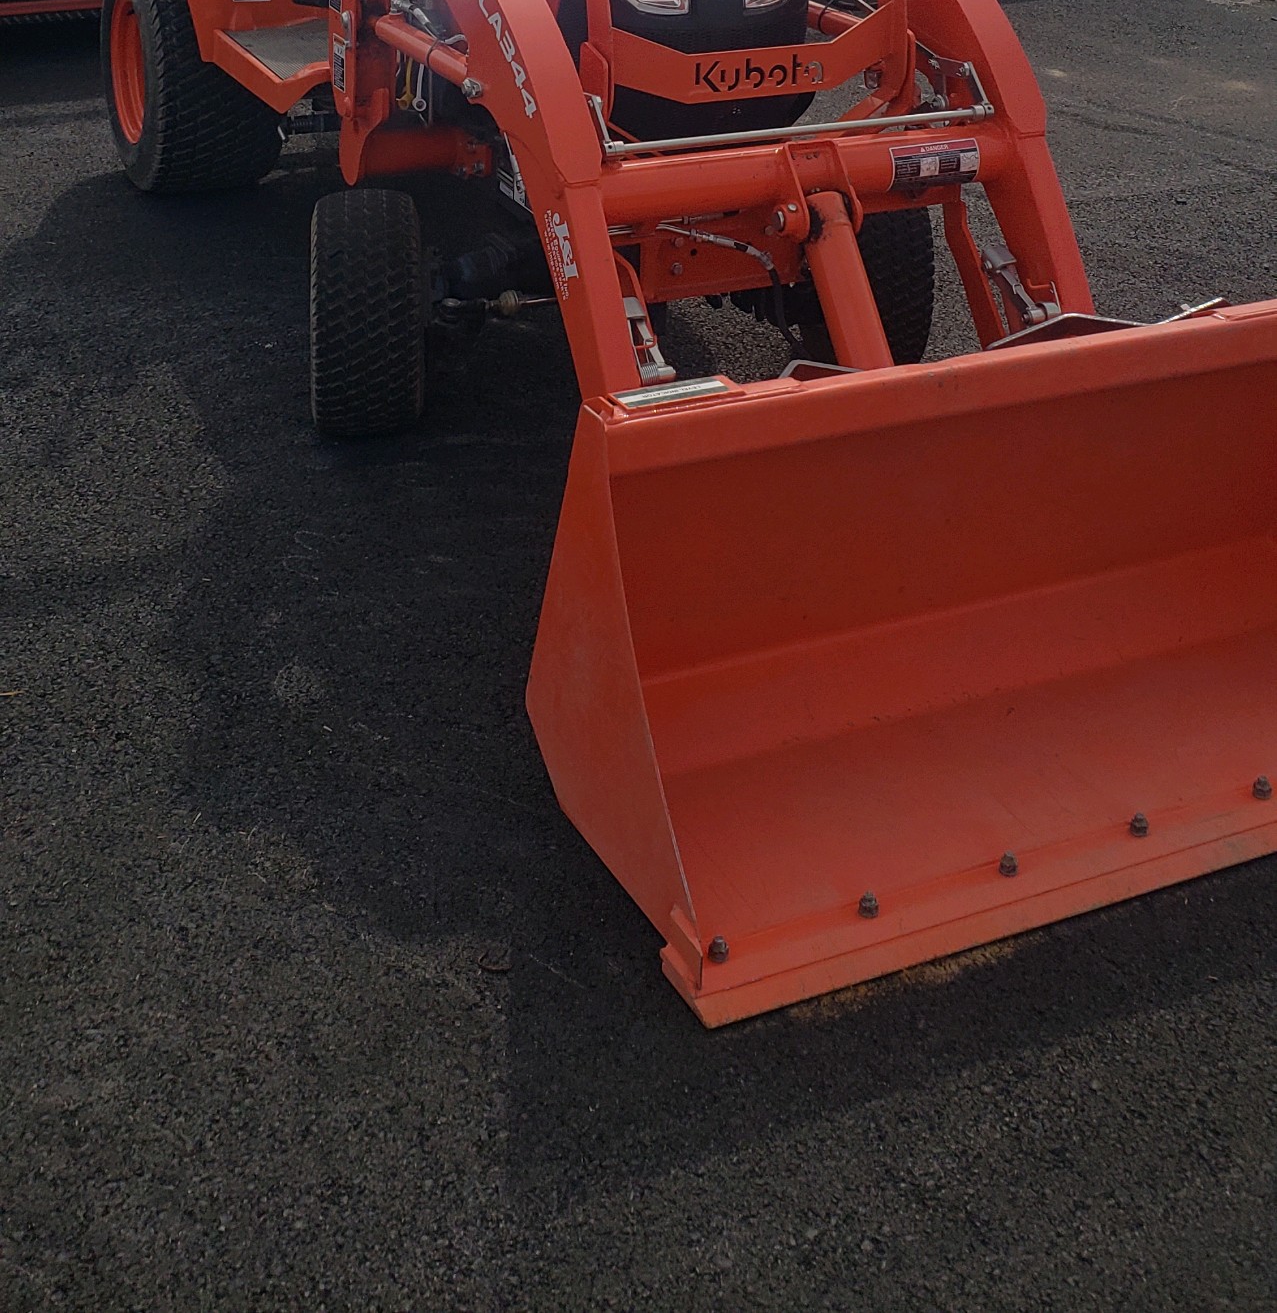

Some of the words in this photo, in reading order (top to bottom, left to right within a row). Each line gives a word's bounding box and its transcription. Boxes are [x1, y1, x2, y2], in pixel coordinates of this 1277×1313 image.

[695, 54, 823, 92] Kubota
[925, 144, 949, 152] DANGER
[553, 212, 579, 281] J&I
